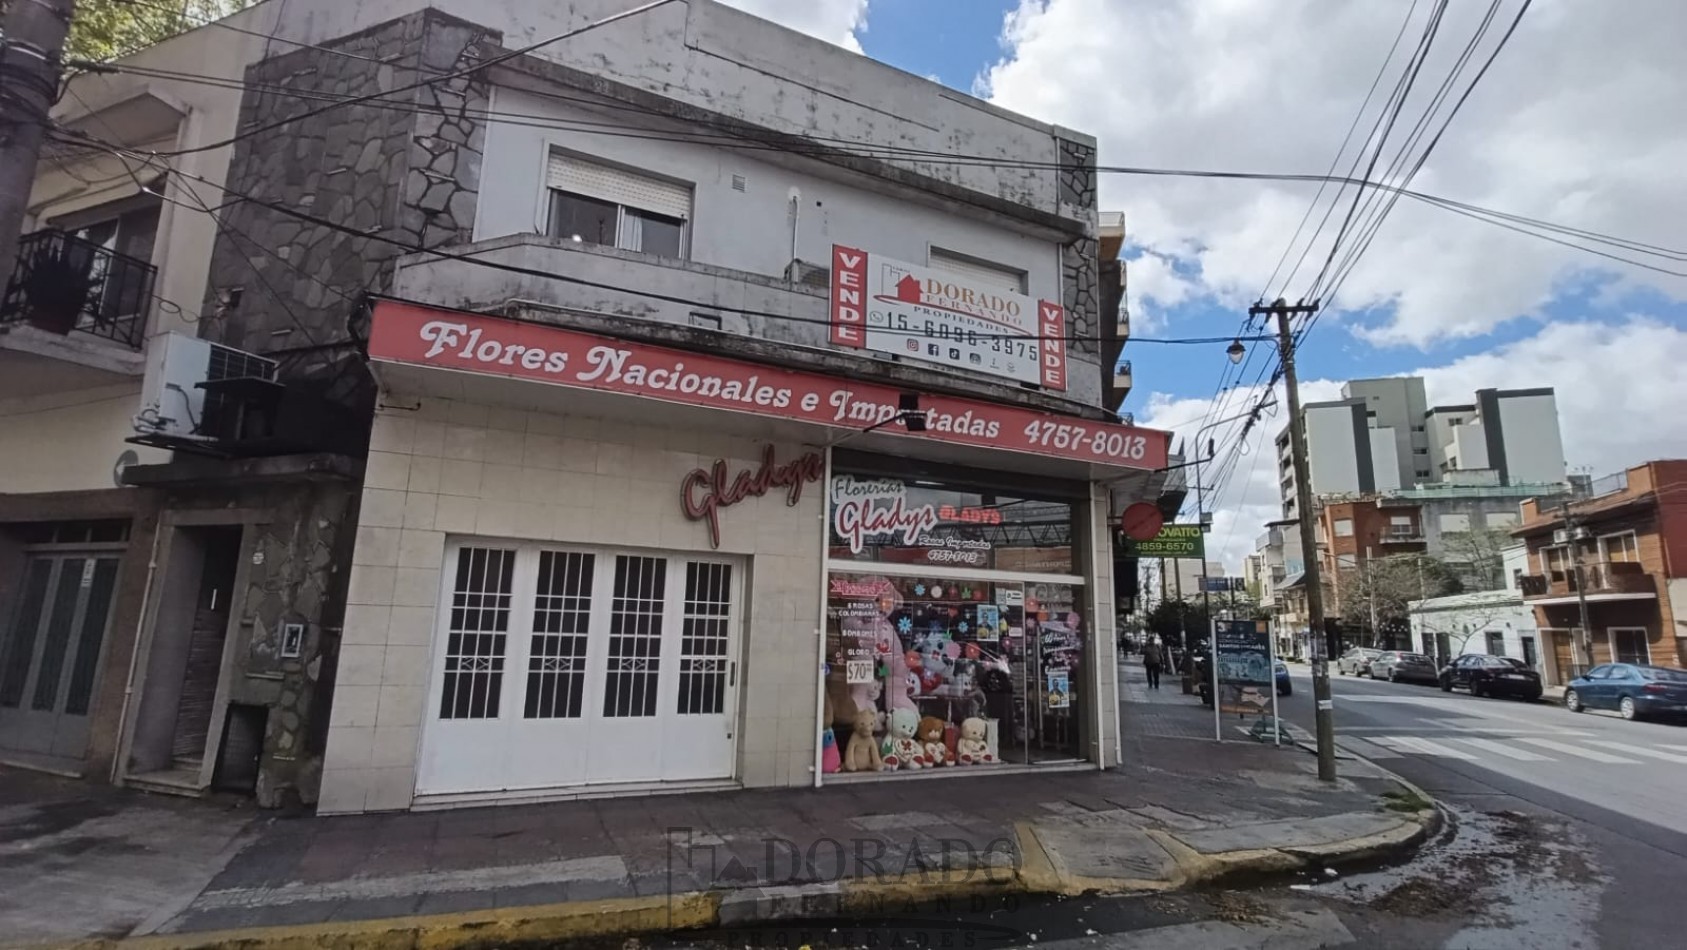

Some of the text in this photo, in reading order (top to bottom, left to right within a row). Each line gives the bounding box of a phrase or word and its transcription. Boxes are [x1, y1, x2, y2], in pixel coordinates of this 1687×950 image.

[838, 252, 860, 341] VENDE
[926, 278, 1021, 316] DORADO
[926, 295, 1023, 326] FERNANDO
[913, 306, 1009, 334] PROPIEDADES
[1043, 307, 1061, 384] VENDE
[420, 321, 568, 373] Flores
[576, 345, 792, 408] Nacionales
[801, 395, 819, 412] e
[1024, 420, 1146, 461] 4757-8013
[838, 498, 935, 551] Gladys
[938, 504, 1001, 524] GLADYS
[1135, 542, 1194, 550] 4859-6570
